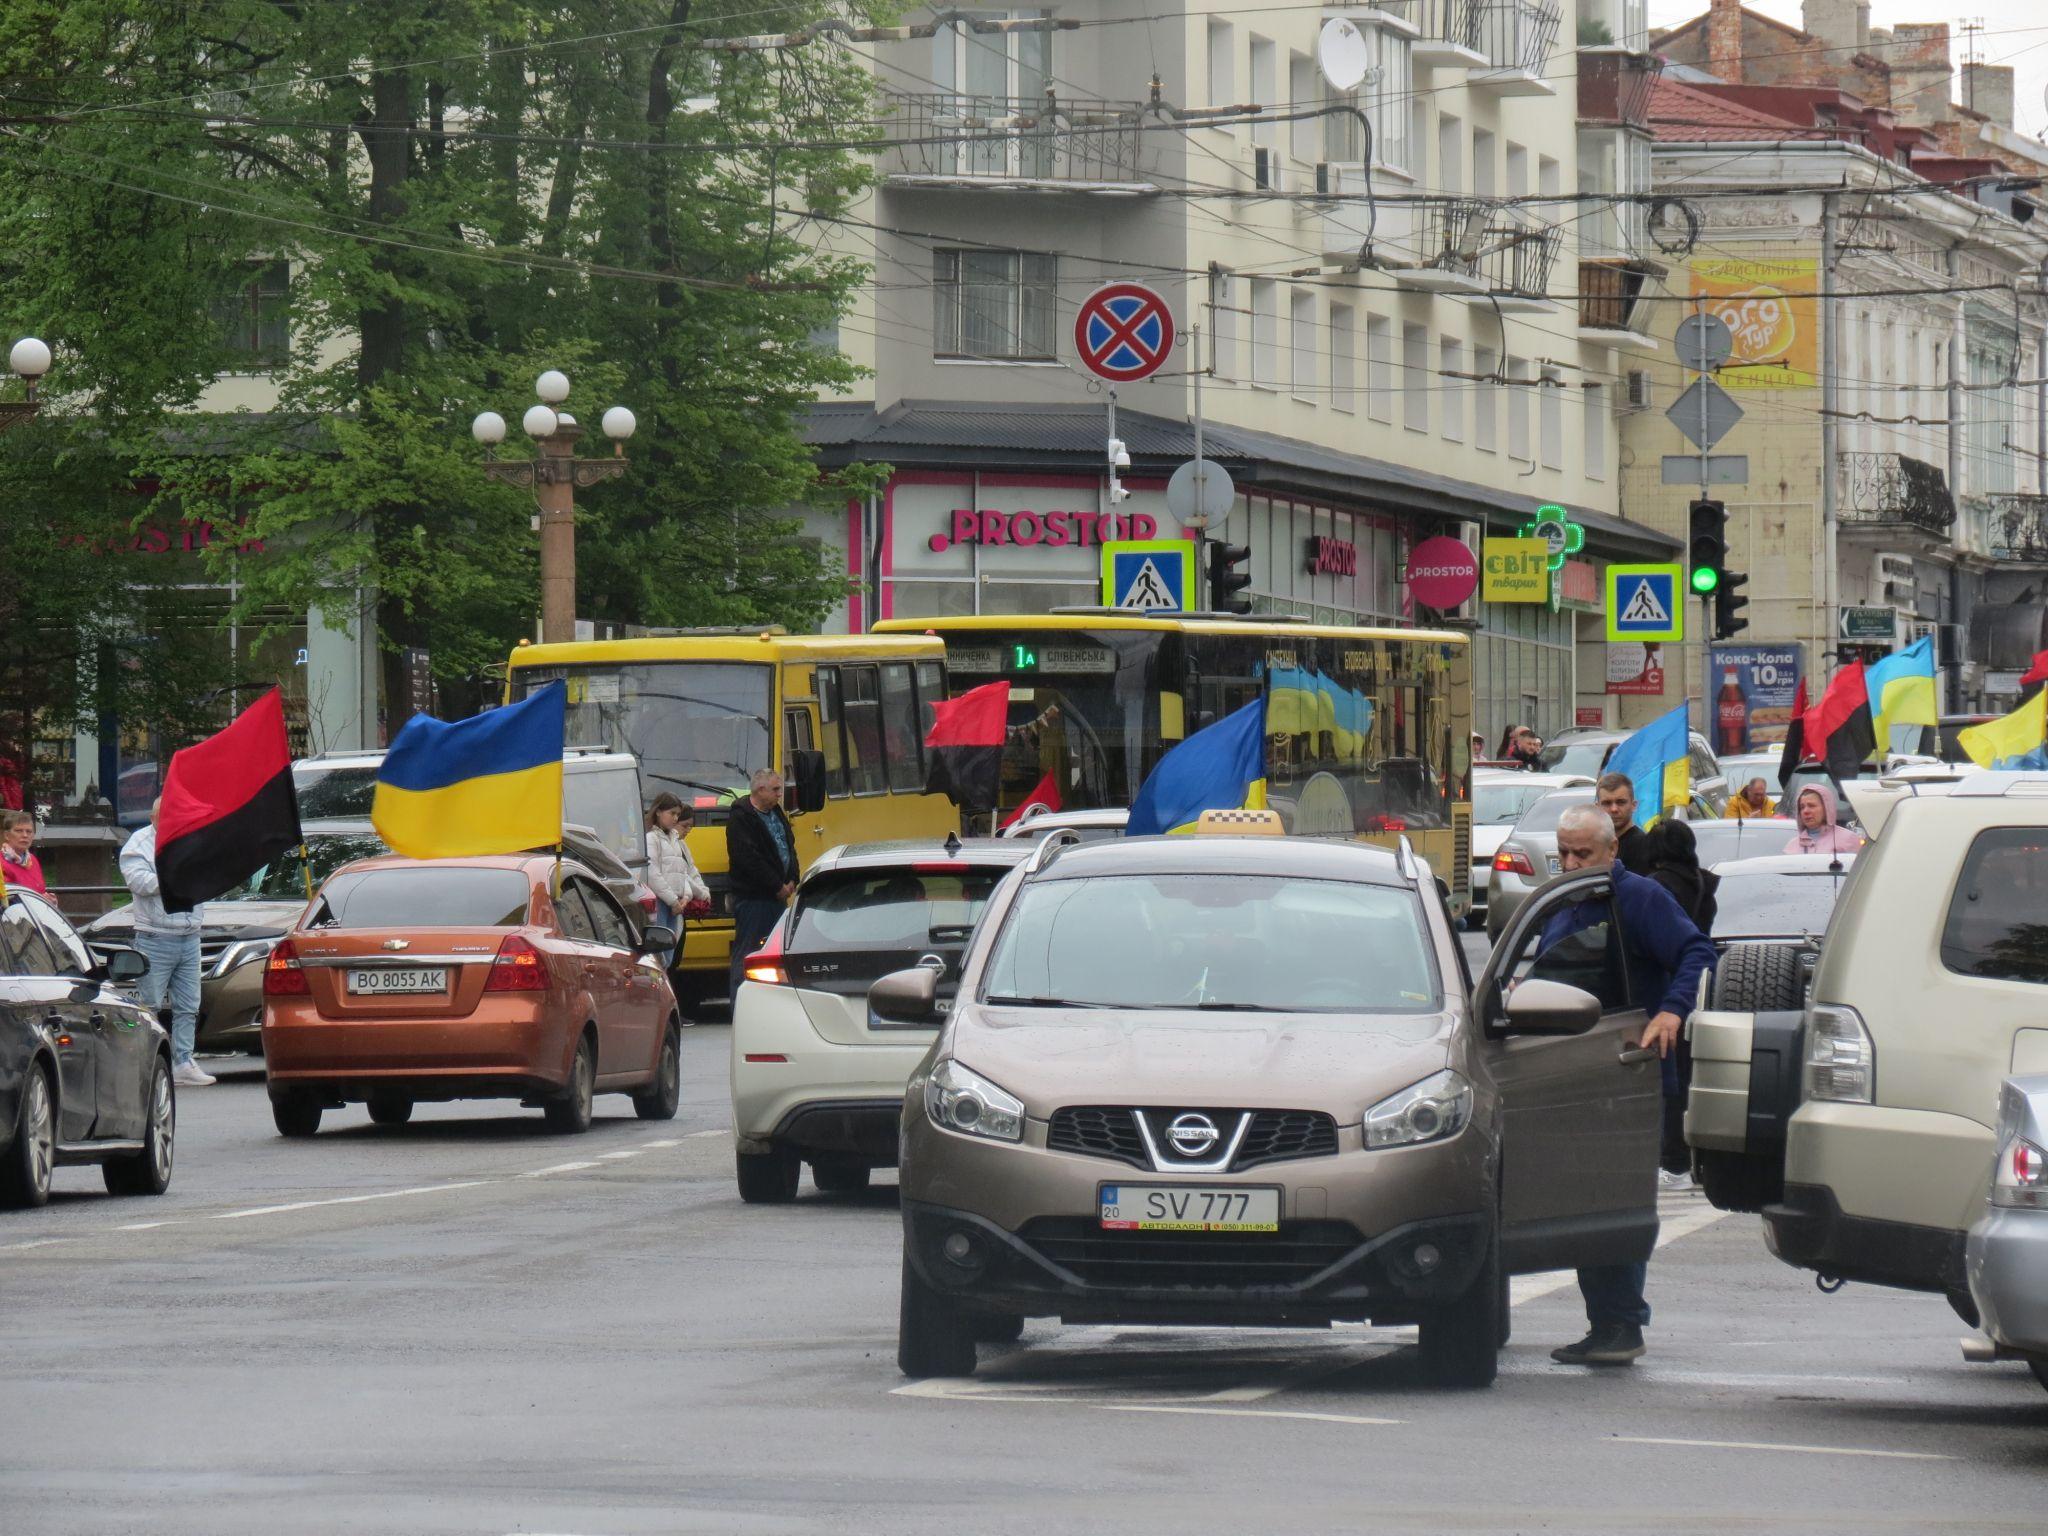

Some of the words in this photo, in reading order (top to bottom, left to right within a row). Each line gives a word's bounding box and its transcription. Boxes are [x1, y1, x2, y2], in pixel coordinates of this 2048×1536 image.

[1485, 550, 1546, 575] СВІТ
[1491, 577, 1539, 591] тварин
[1715, 653, 1794, 665] Кока-Кола
[1750, 665, 1778, 685] 10
[1777, 677, 1794, 686] грн
[803, 964, 839, 973] LEAF
[383, 972, 417, 988] 8055
[1172, 1130, 1214, 1138] NISSAN
[1103, 1206, 1120, 1218] 20
[1146, 1192, 1191, 1220] SV
[1199, 1193, 1250, 1221] 777
